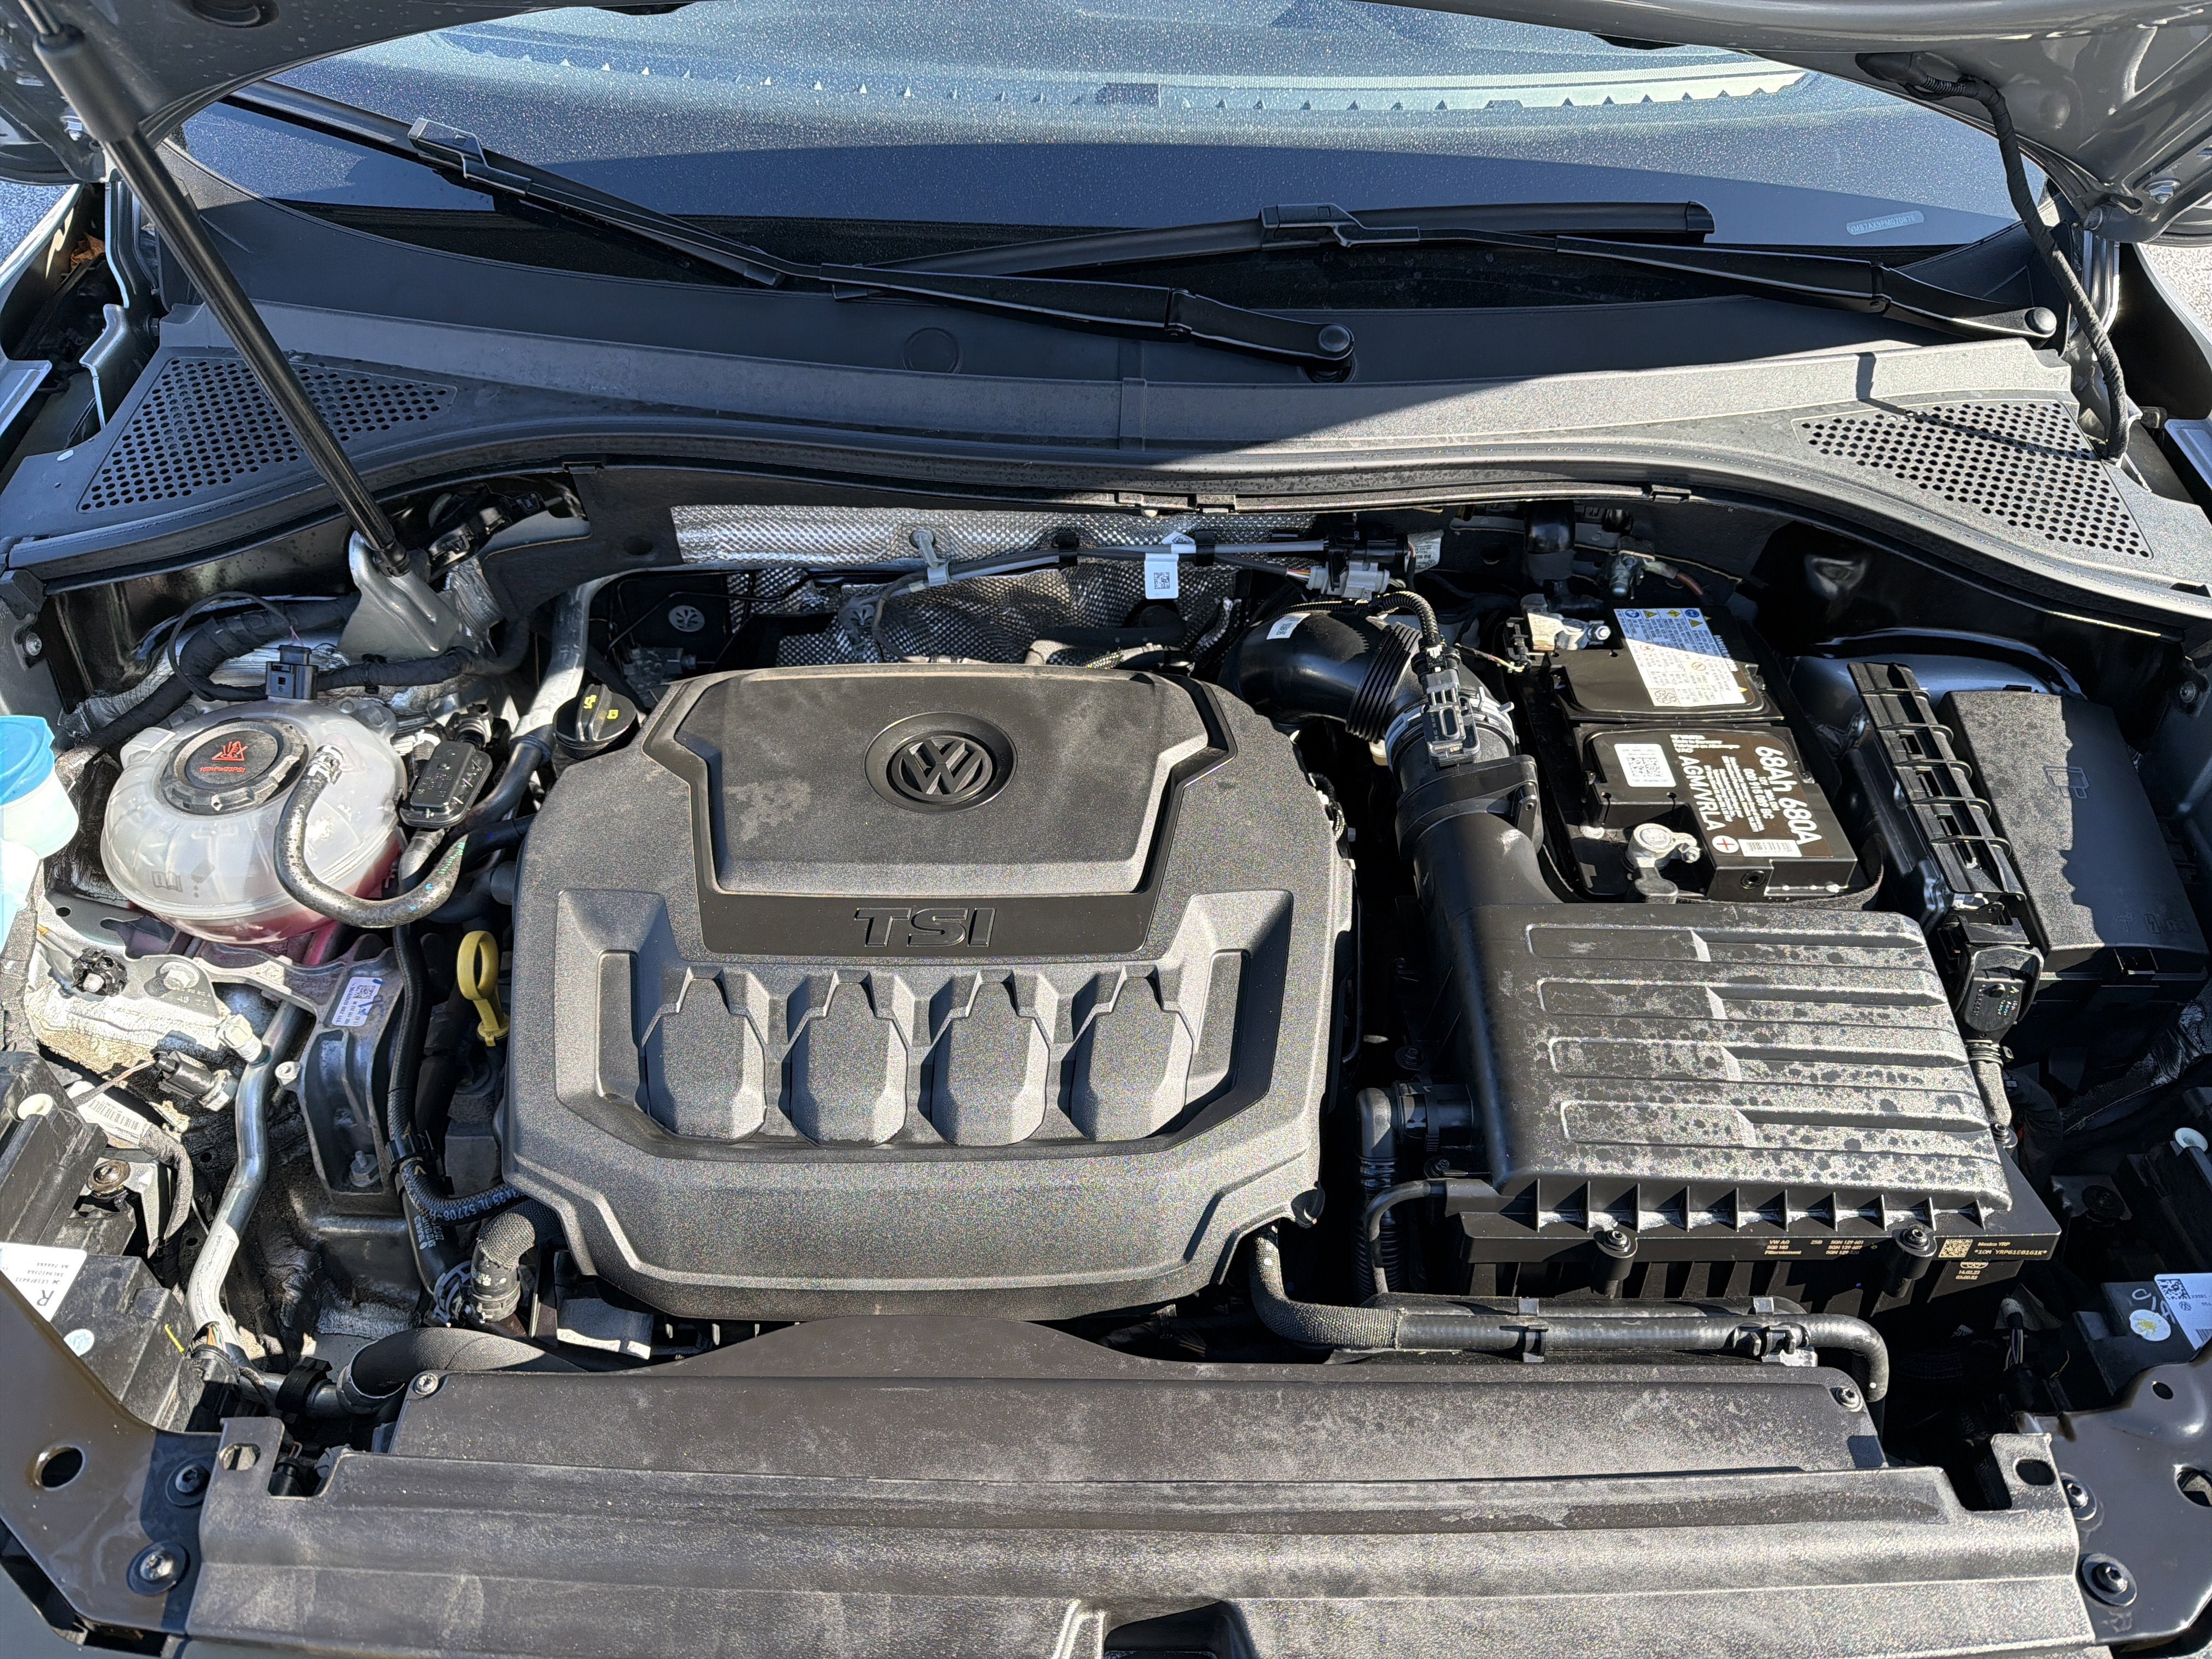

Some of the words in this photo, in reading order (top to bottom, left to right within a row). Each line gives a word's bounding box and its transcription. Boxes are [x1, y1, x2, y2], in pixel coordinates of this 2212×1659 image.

[1678, 756, 1725, 831] AGM/VRLA
[1755, 747, 1797, 791] 68Ah
[1779, 797, 1822, 845] 680A
[853, 906, 997, 948] TSI
[36, 1289, 54, 1306] R
